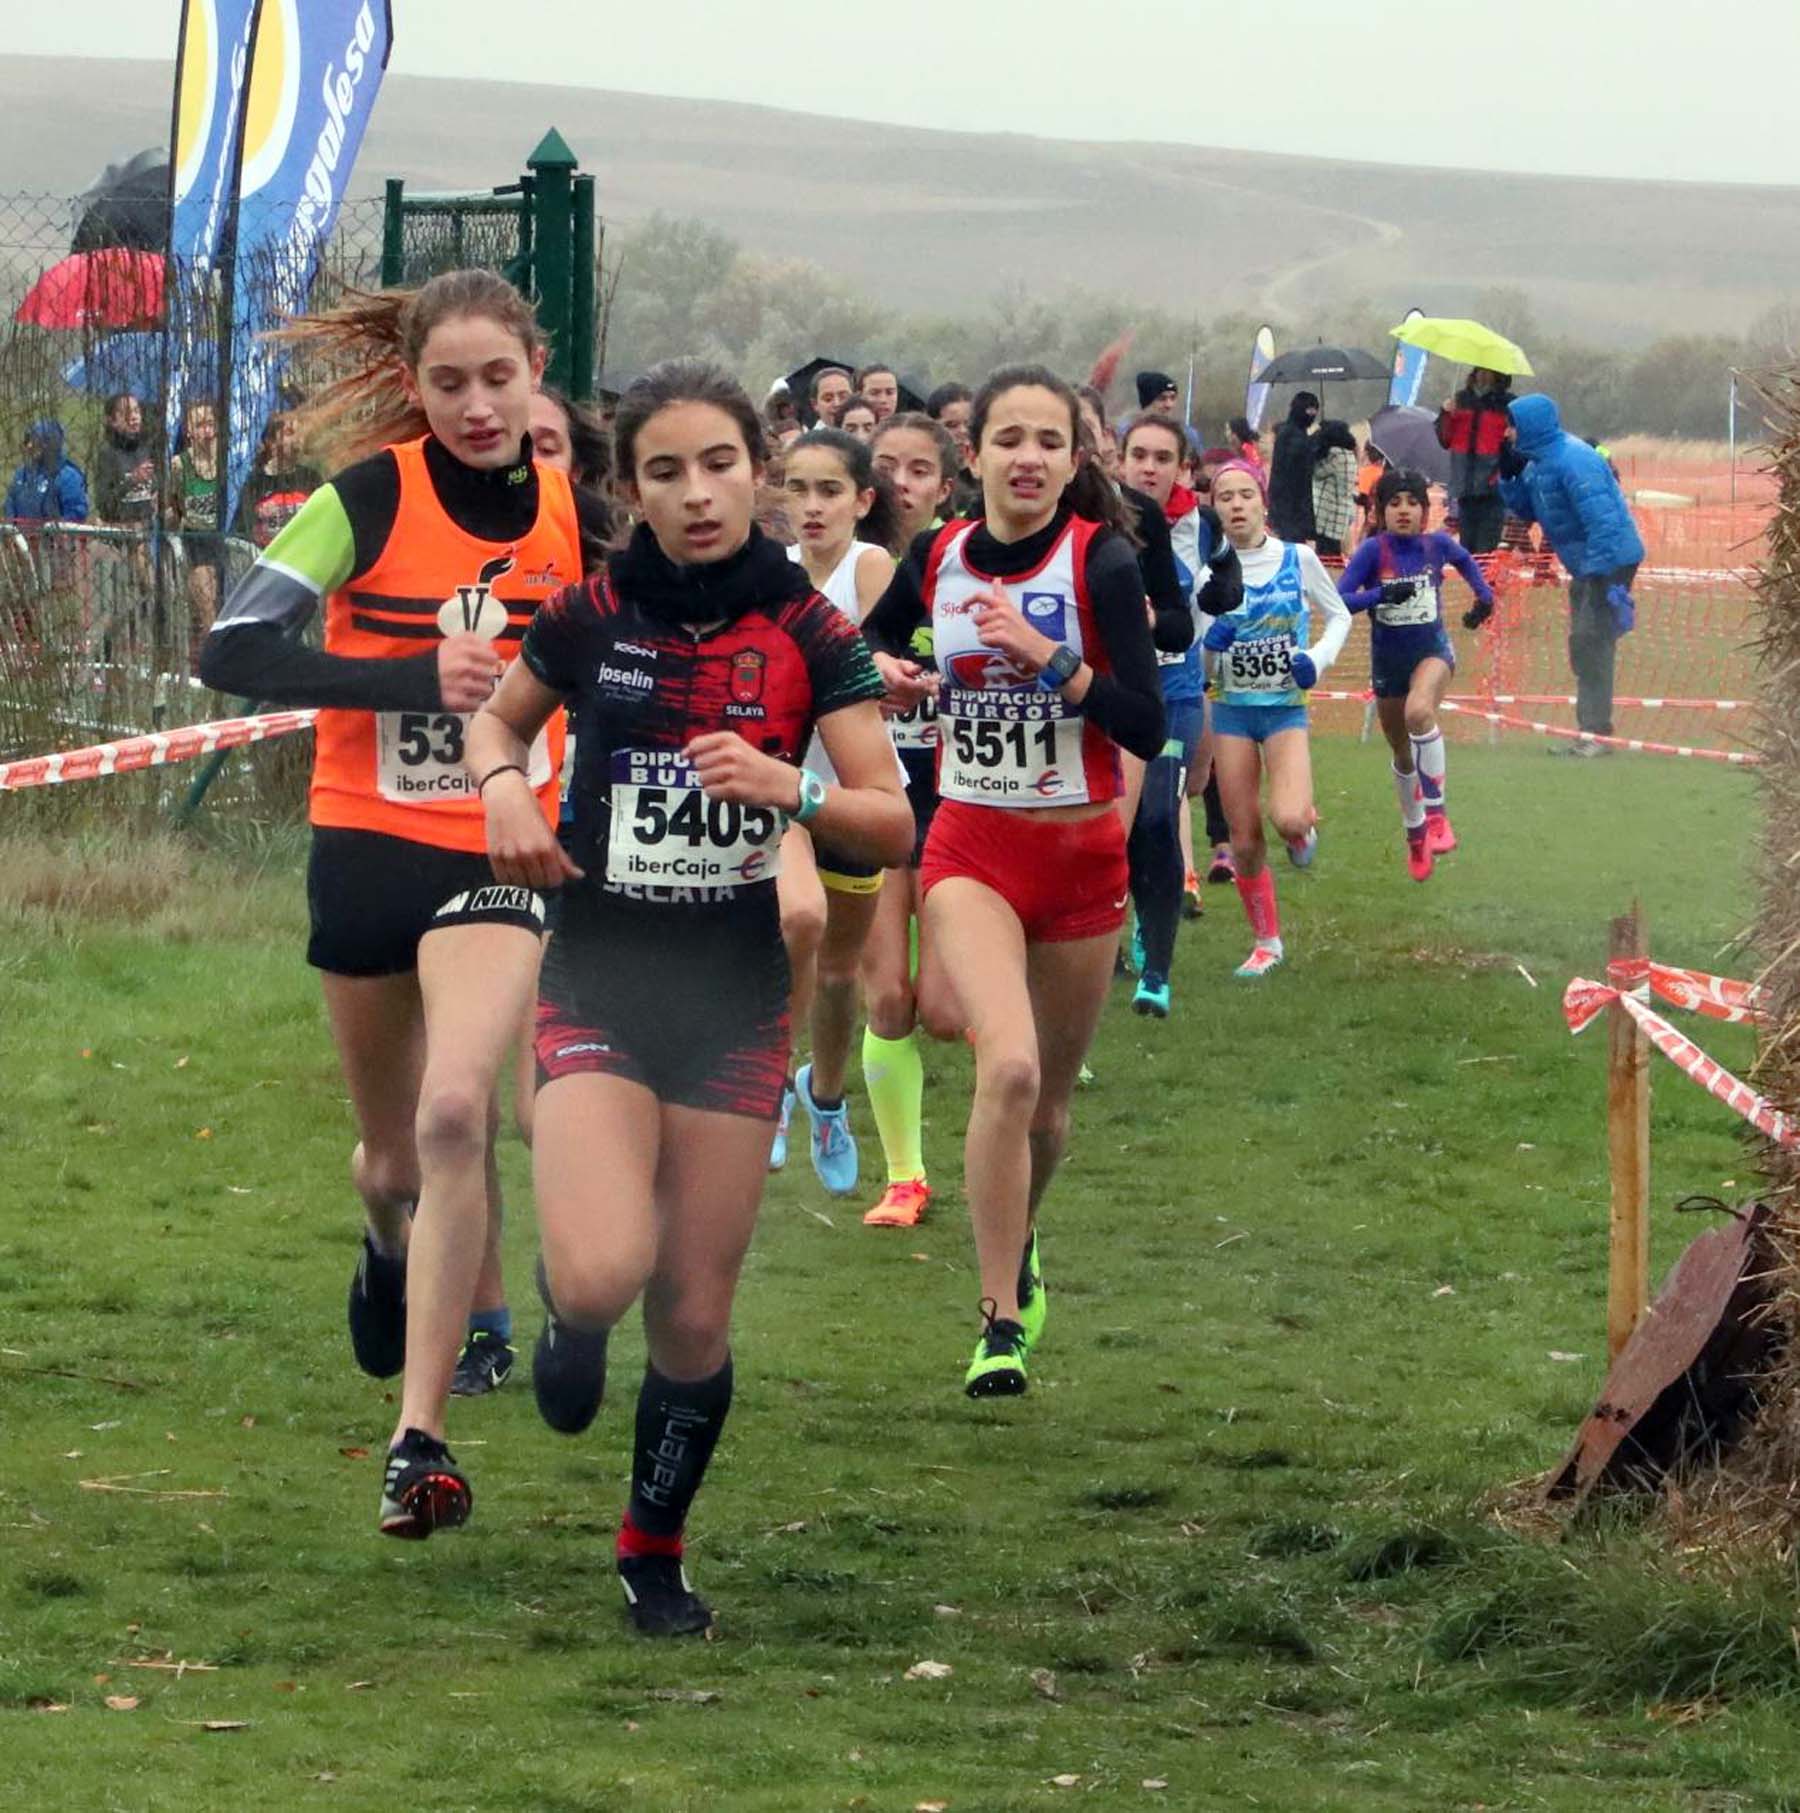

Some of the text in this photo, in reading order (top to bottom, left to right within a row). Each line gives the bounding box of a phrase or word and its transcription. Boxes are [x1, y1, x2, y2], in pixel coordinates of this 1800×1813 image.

[598, 661, 654, 690] joselin
[1231, 651, 1292, 678] 5363
[726, 705, 765, 717] SELAYA
[950, 701, 1064, 721] BURGOS
[398, 714, 466, 766] 53
[953, 718, 1057, 768] 5511
[630, 752, 690, 768] DIPU
[630, 768, 703, 787] BUR
[953, 770, 1020, 794] iberCaja
[633, 788, 774, 847] 5405
[628, 854, 721, 880] iberCaja
[470, 887, 530, 911] NIKE
